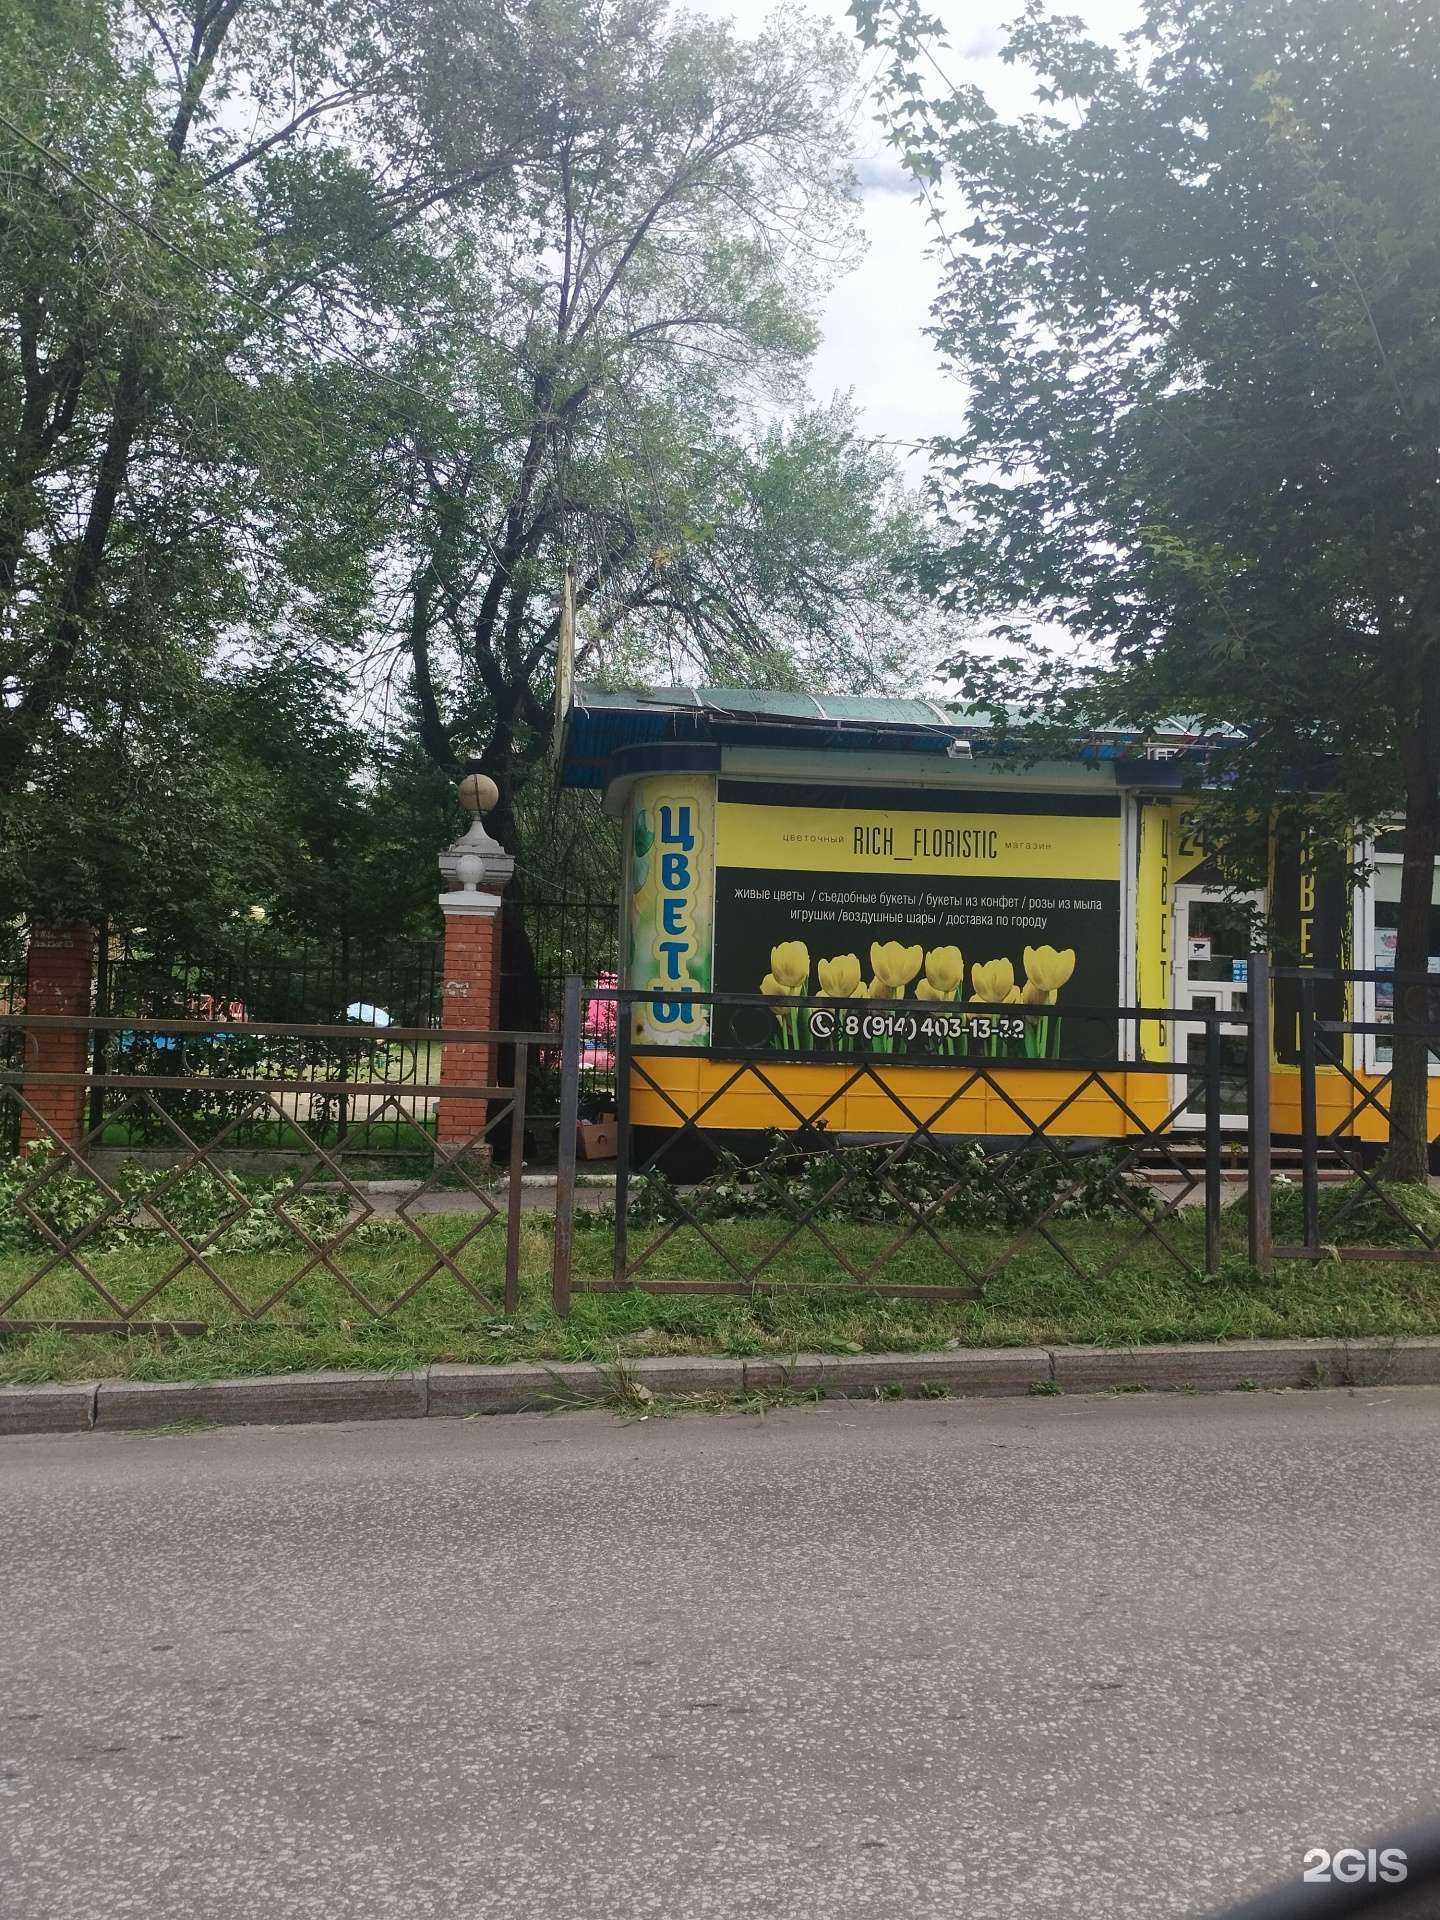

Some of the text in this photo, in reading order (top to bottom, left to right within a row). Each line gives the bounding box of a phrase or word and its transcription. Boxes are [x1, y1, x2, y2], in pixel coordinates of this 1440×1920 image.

[783, 825, 1052, 861] цветочный RICH_FLORISTIC магазин
[734, 887, 770, 900] живые
[773, 890, 805, 903] цветы
[818, 890, 877, 904] съедобные
[879, 890, 916, 906] букеты
[926, 893, 963, 908] букеты
[965, 896, 978, 906] из
[980, 895, 1019, 910] конфет
[1028, 898, 1055, 911] розы
[1058, 899, 1071, 910] из
[1073, 899, 1102, 910] мыла
[652, 805, 695, 1025] ЦВЕТЫ
[790, 909, 835, 923] игрушки
[906, 912, 936, 925] шары
[945, 913, 993, 926] доставка
[996, 915, 1009, 925] по
[1011, 915, 1047, 929] городу
